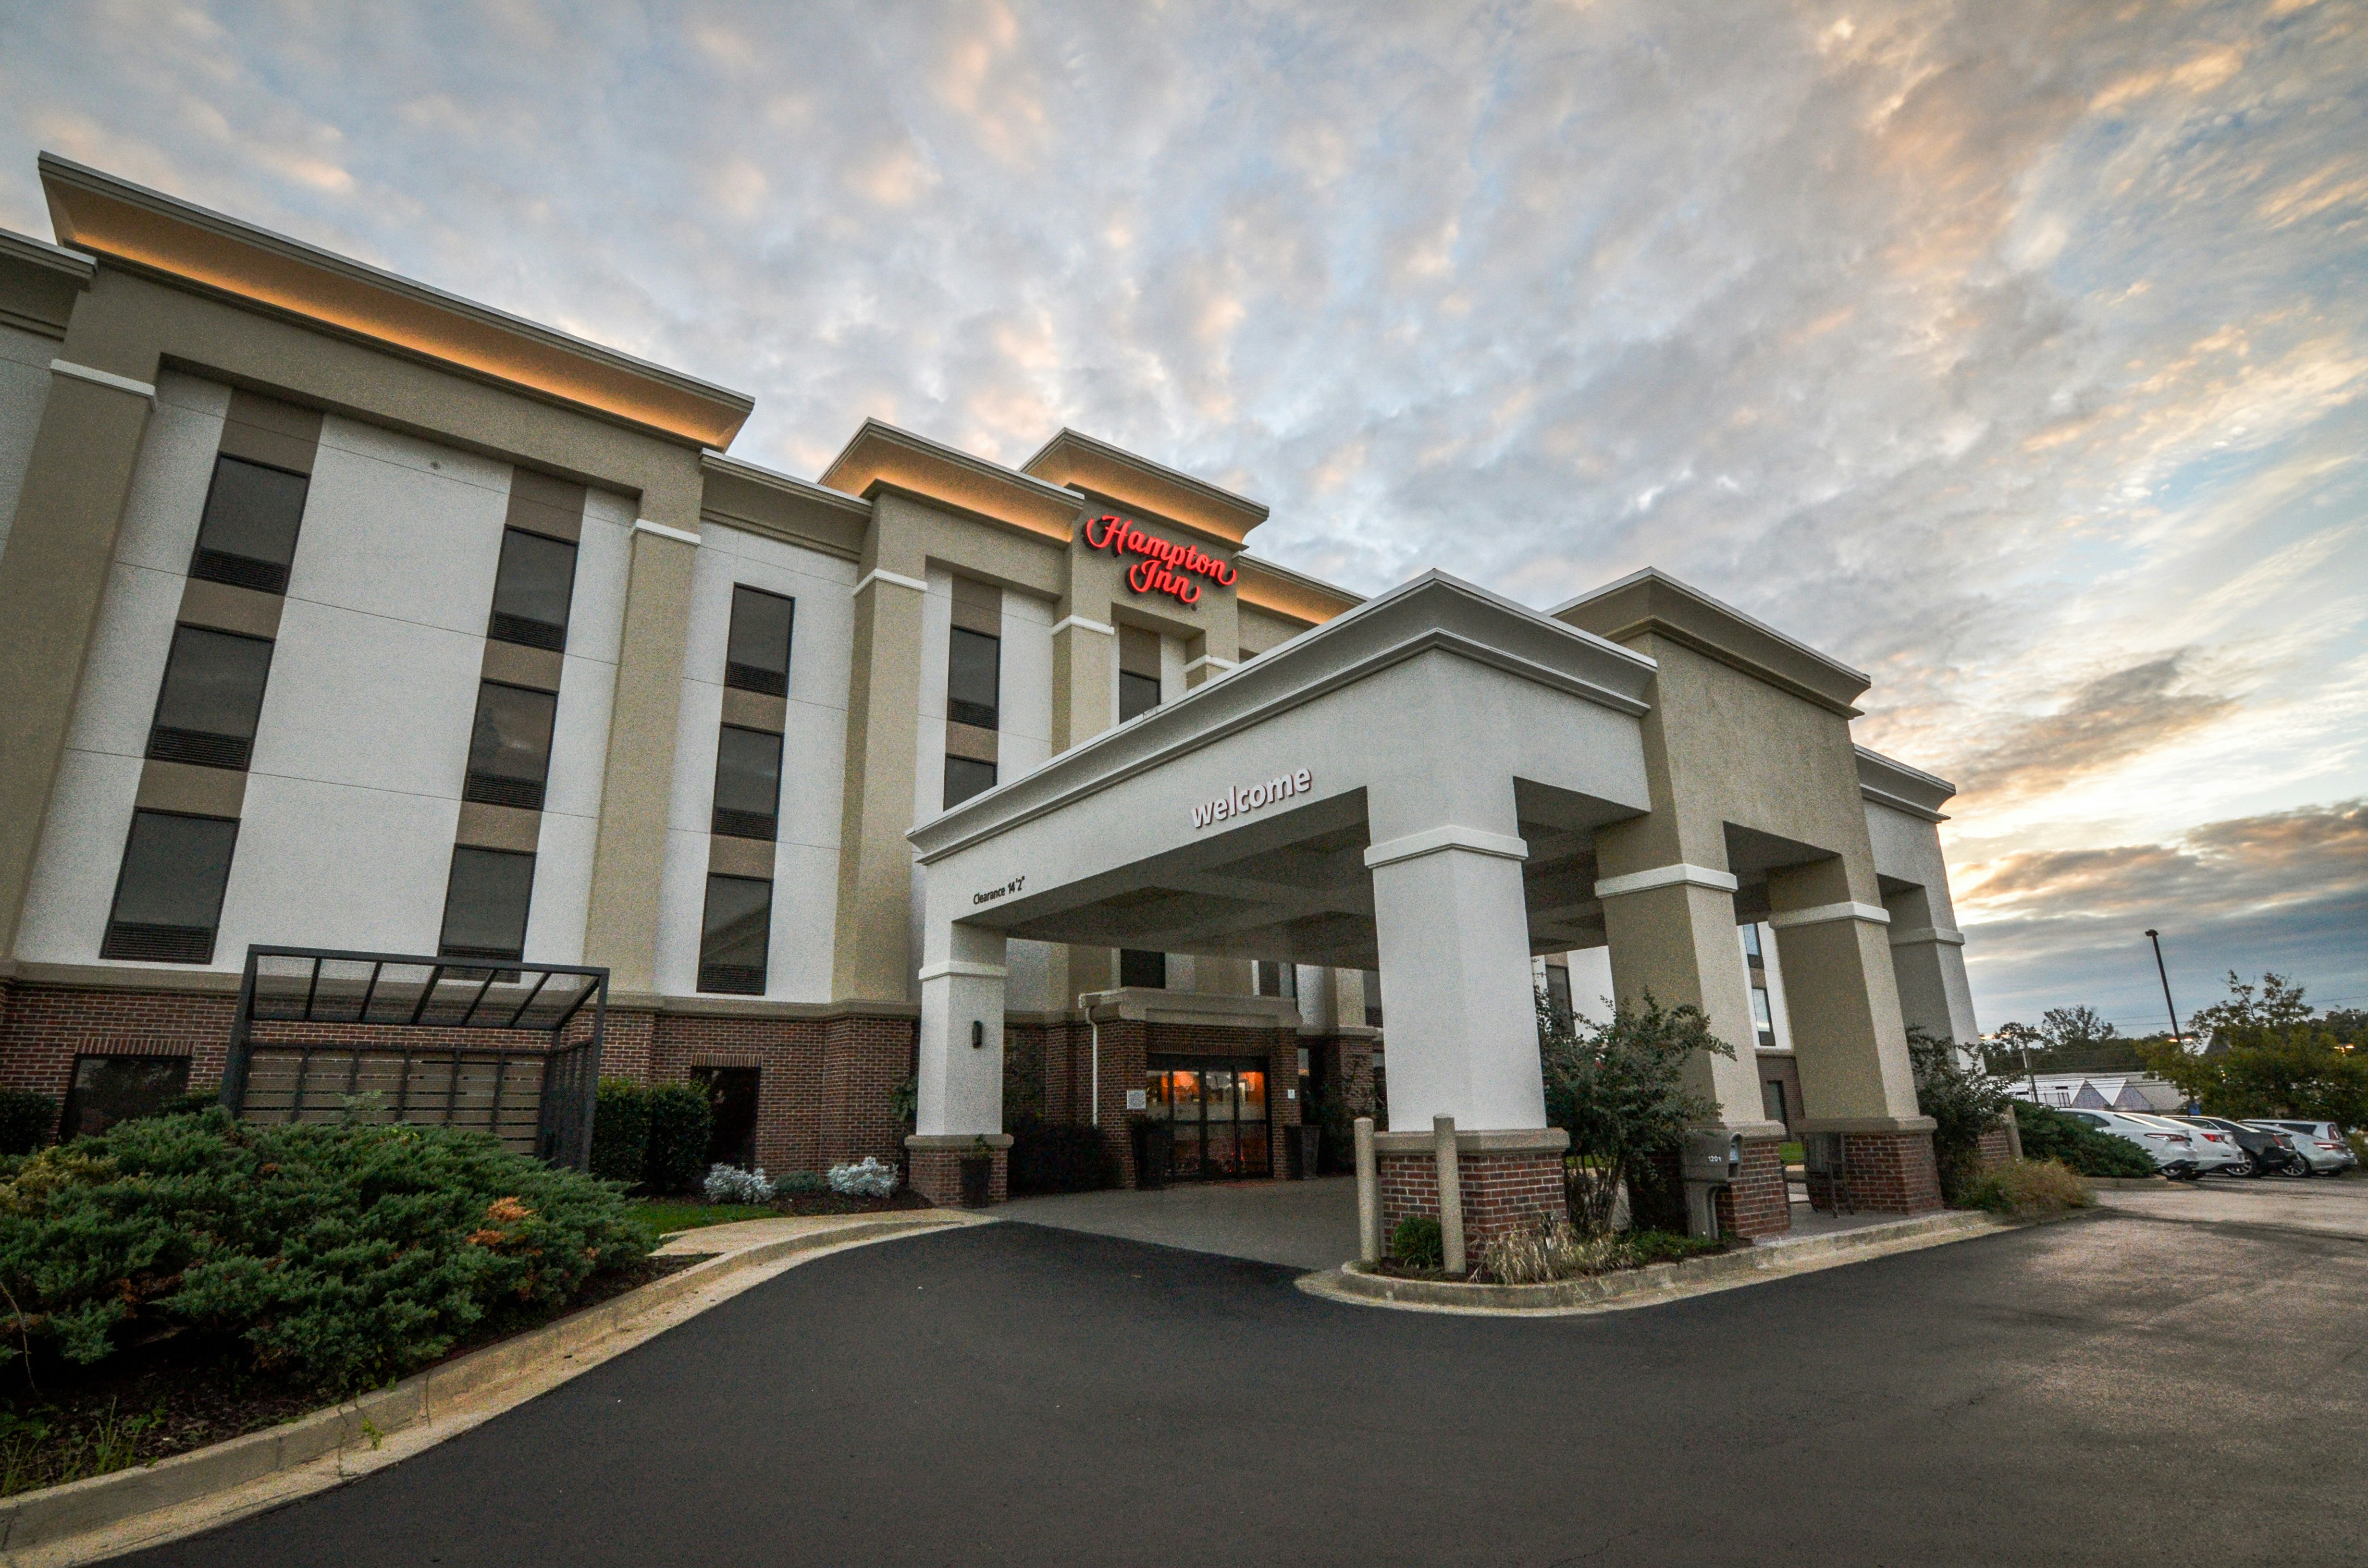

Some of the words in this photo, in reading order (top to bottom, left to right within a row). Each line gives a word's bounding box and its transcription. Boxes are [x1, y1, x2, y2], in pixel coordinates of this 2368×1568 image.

[1085, 514, 1237, 586] Hampton
[1129, 559, 1201, 604] Inn
[1191, 768, 1312, 829] welcome
[973, 887, 1006, 905] Clearance
